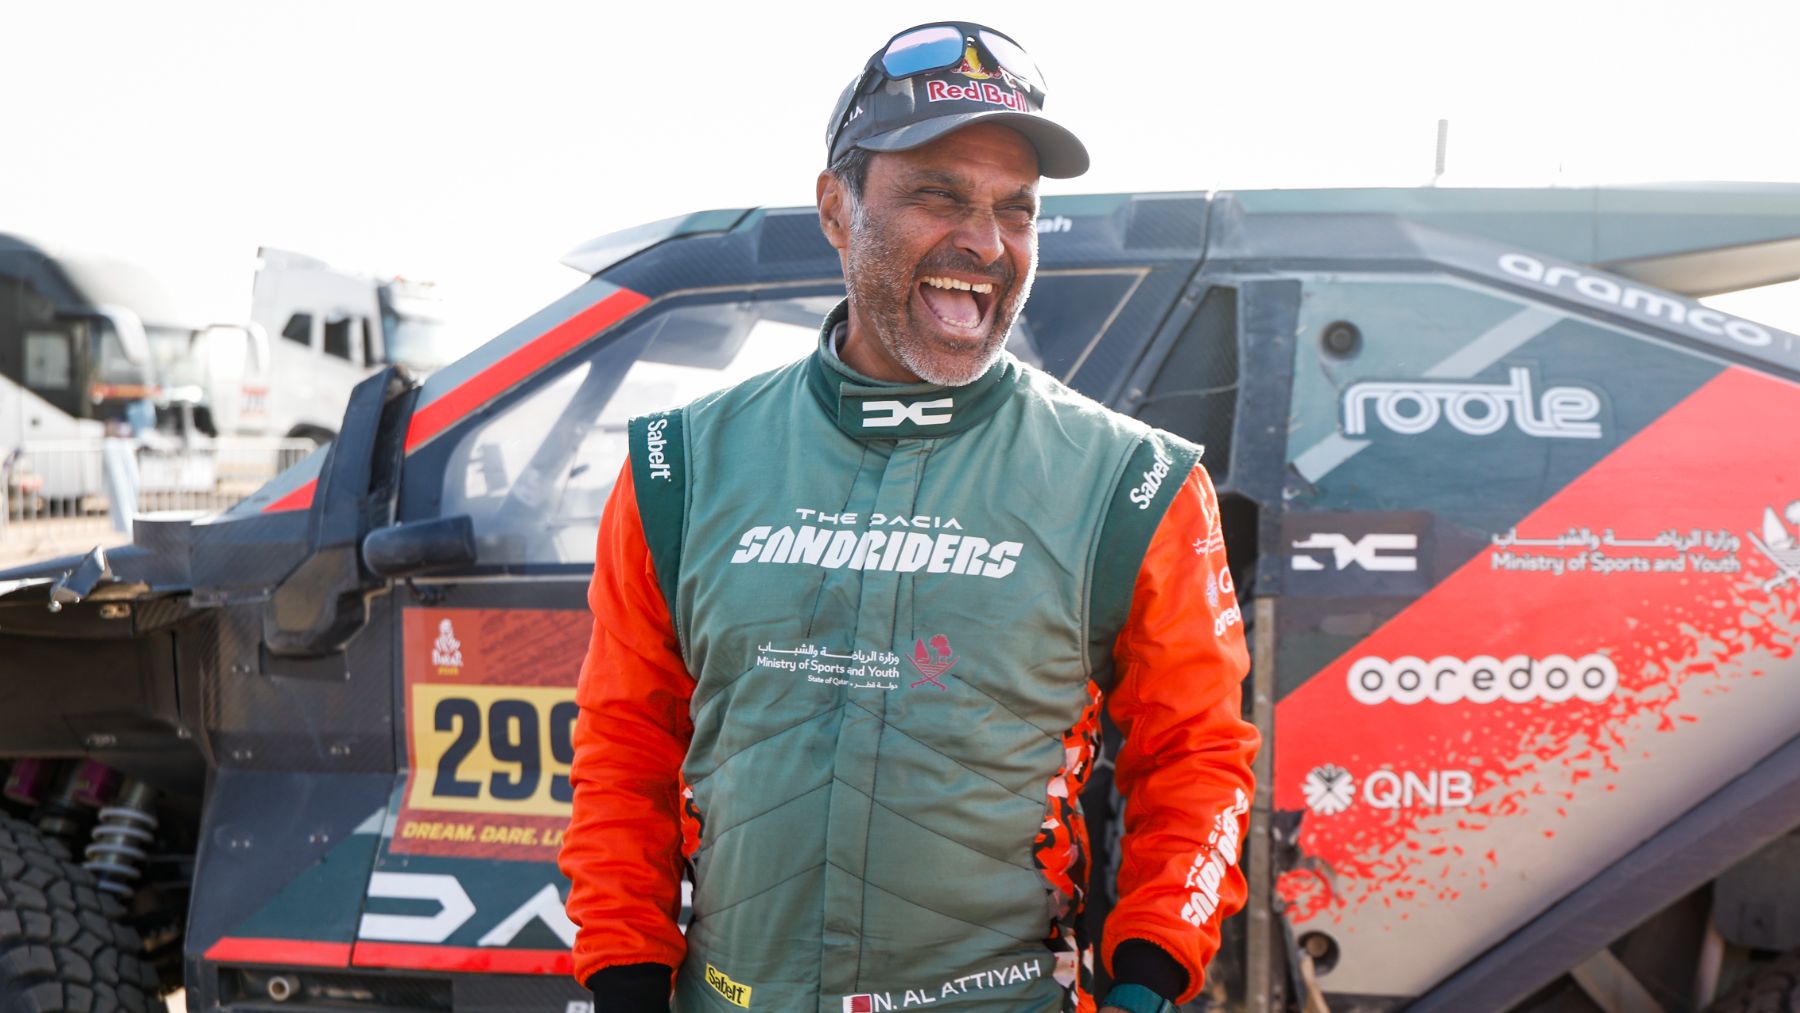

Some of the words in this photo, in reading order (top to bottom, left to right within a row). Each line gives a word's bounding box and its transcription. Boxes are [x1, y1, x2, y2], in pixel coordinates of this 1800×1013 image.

[927, 80, 982, 102] Red
[981, 83, 1029, 112] Bull
[1498, 253, 1773, 347] aramco
[1342, 366, 1603, 439] roole
[647, 418, 671, 481] Sabelt
[795, 508, 858, 525] THE
[869, 513, 963, 530] DACIA
[730, 525, 1024, 579] SANDRIDERS
[1491, 551, 1564, 575] Ministry
[1567, 552, 1589, 571] of
[1590, 552, 1650, 574] Sports
[1653, 553, 1686, 572] and
[1688, 553, 1742, 573] Youth
[756, 656, 797, 672] Ministry
[798, 659, 810, 670] of
[810, 659, 845, 674] Sports
[847, 665, 865, 676] and
[868, 666, 899, 678] Youth
[807, 675, 824, 683] State
[824, 676, 833, 684] of
[1356, 655, 1609, 695] ooredoo
[432, 697, 580, 804] 299
[1362, 769, 1475, 809] QNB
[402, 821, 476, 843] DREAM.
[480, 824, 539, 845] DARE.
[708, 966, 745, 1004] Sabelt
[873, 992, 898, 1013] N.
[903, 989, 936, 1008] AL
[940, 959, 1041, 998] ATTIYAH
